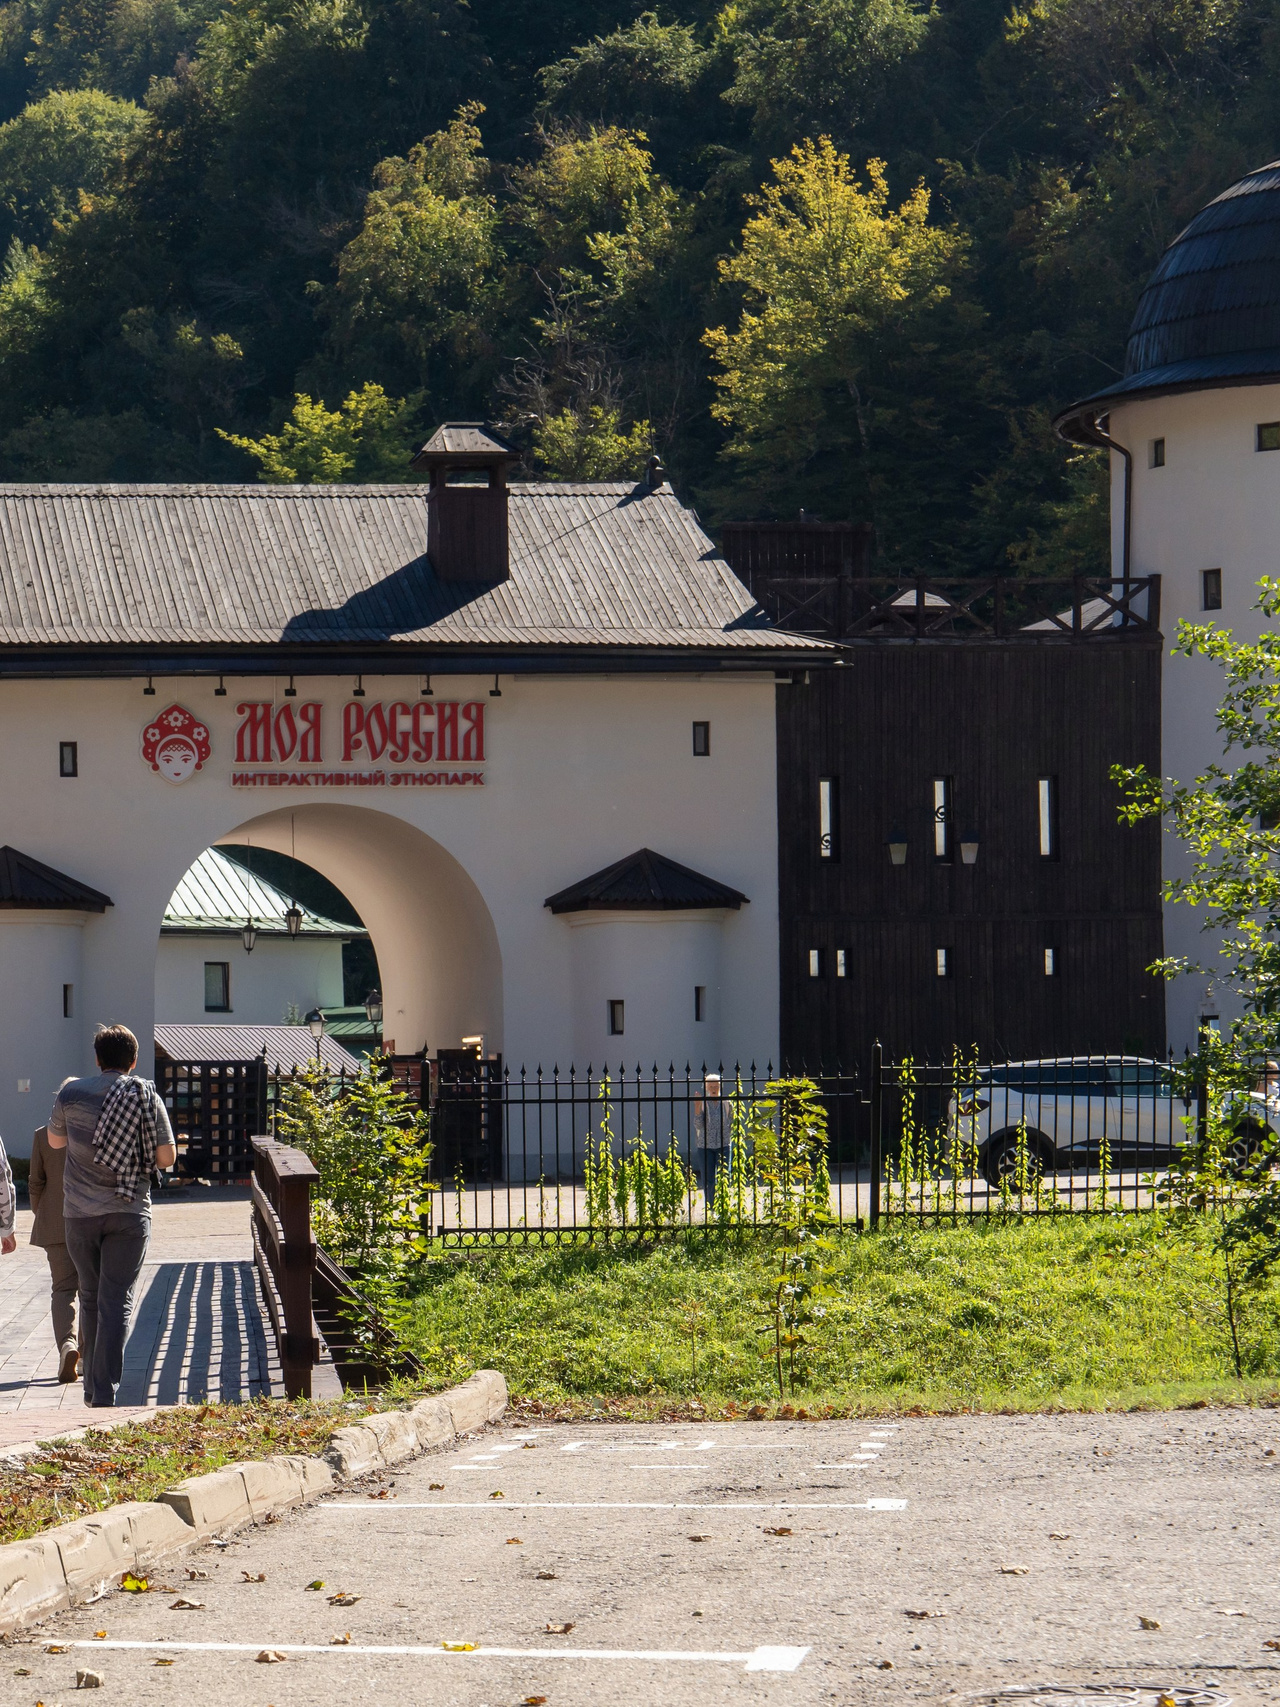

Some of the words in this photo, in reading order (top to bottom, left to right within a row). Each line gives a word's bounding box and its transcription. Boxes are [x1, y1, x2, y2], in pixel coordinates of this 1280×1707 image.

[234, 702, 324, 763] МОЯ
[341, 702, 487, 763] РОССИЯ
[232, 770, 386, 787] ИНТЕРАКТИВНЫЙ
[389, 772, 486, 787] ЭТНОПАРК
